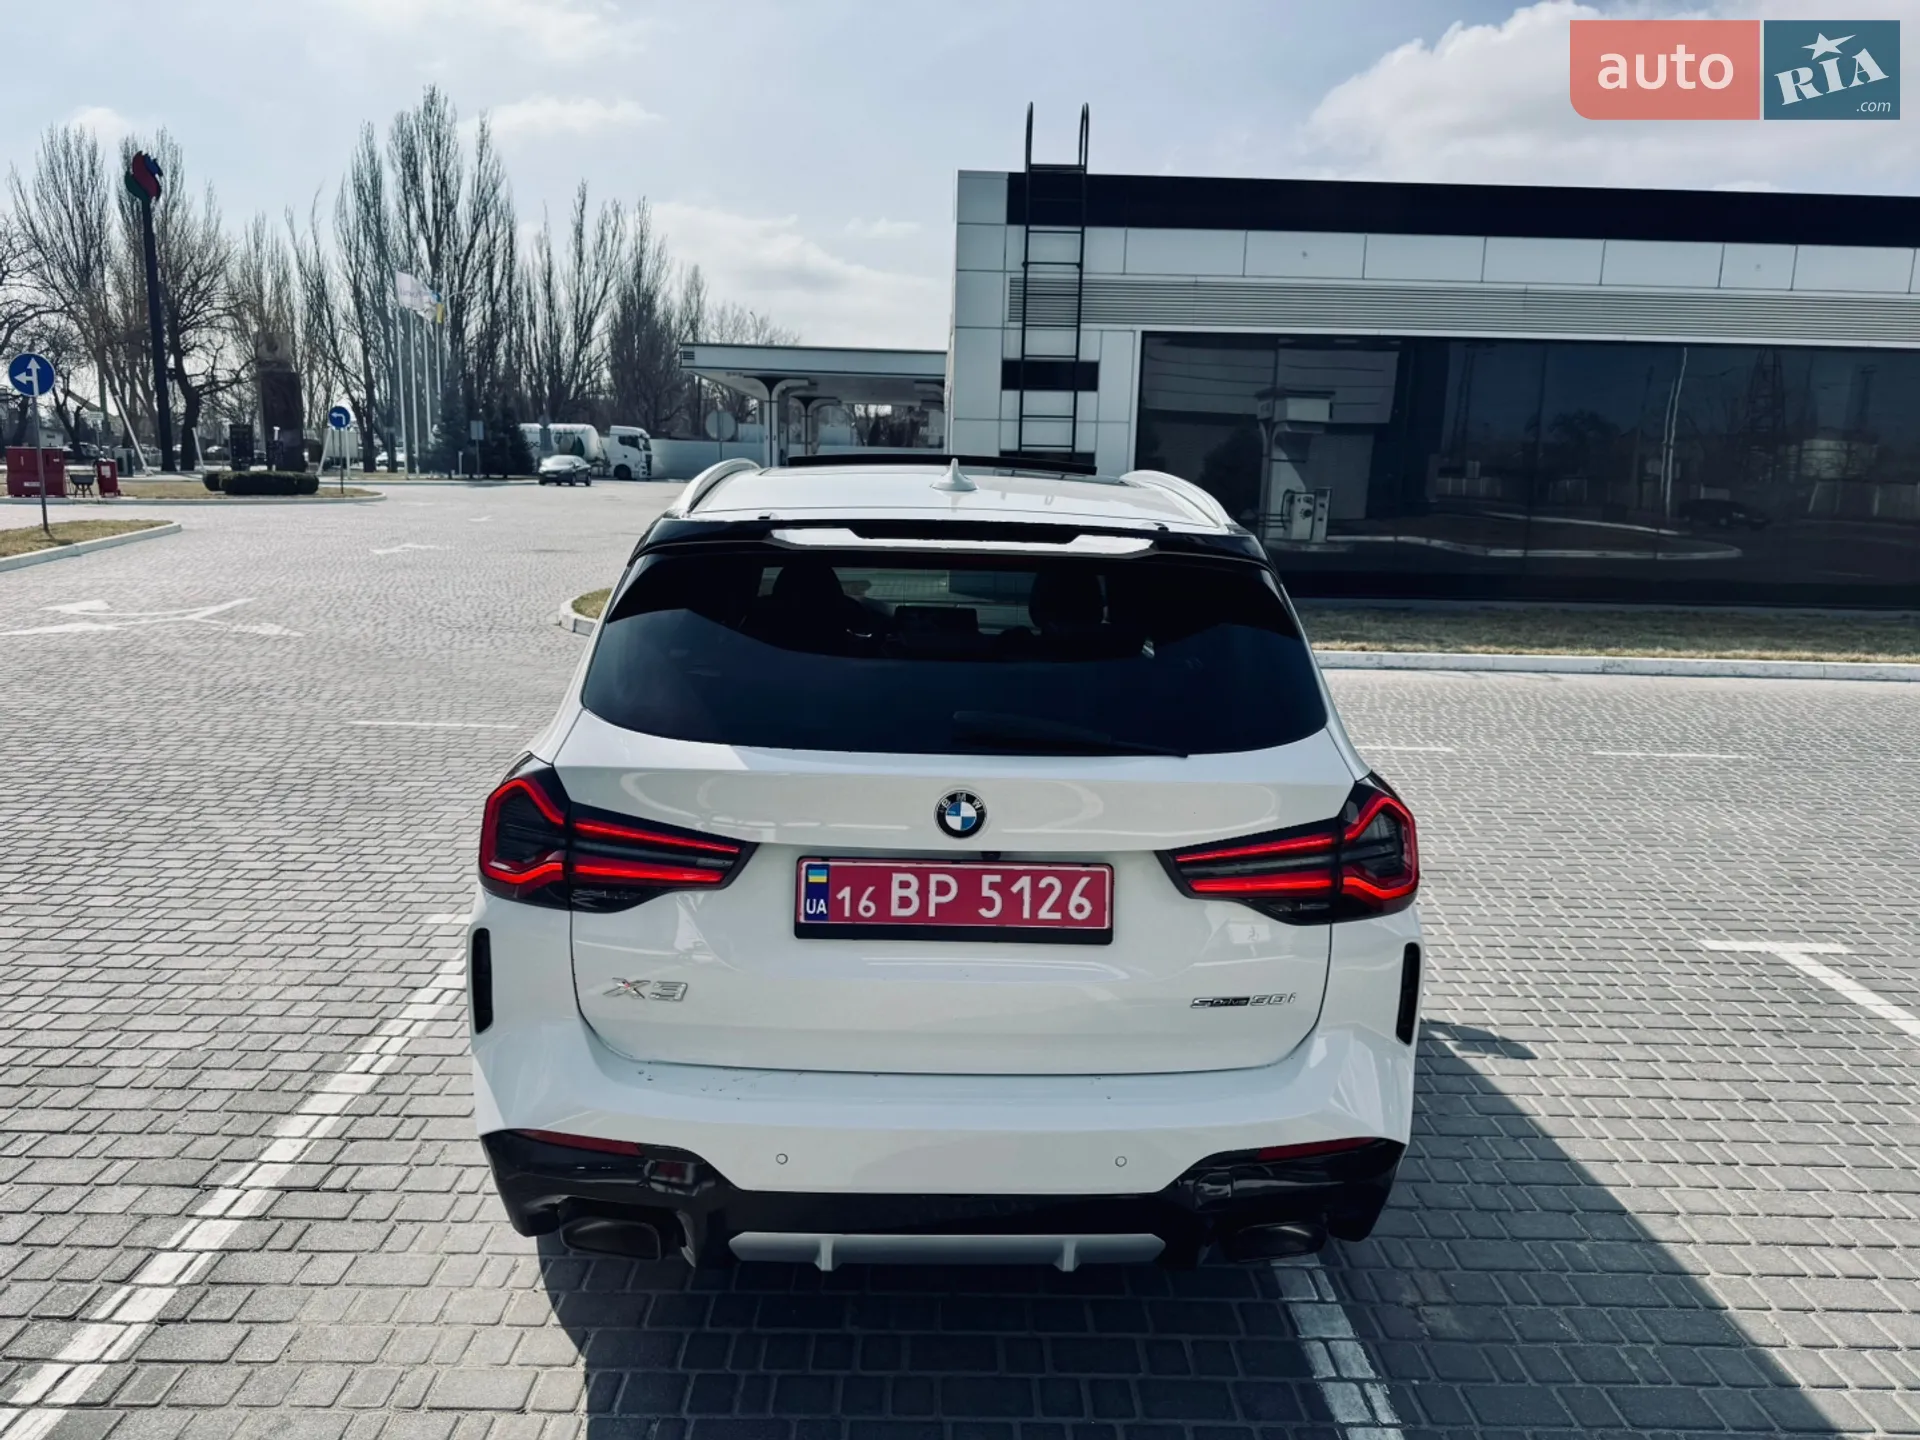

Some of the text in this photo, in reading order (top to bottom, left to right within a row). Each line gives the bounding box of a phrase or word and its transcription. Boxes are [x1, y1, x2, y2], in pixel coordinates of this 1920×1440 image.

[940, 792, 983, 810] BMW
[805, 898, 828, 915] UA
[836, 872, 1093, 920] 16 BP 5126
[602, 977, 688, 1002] X3
